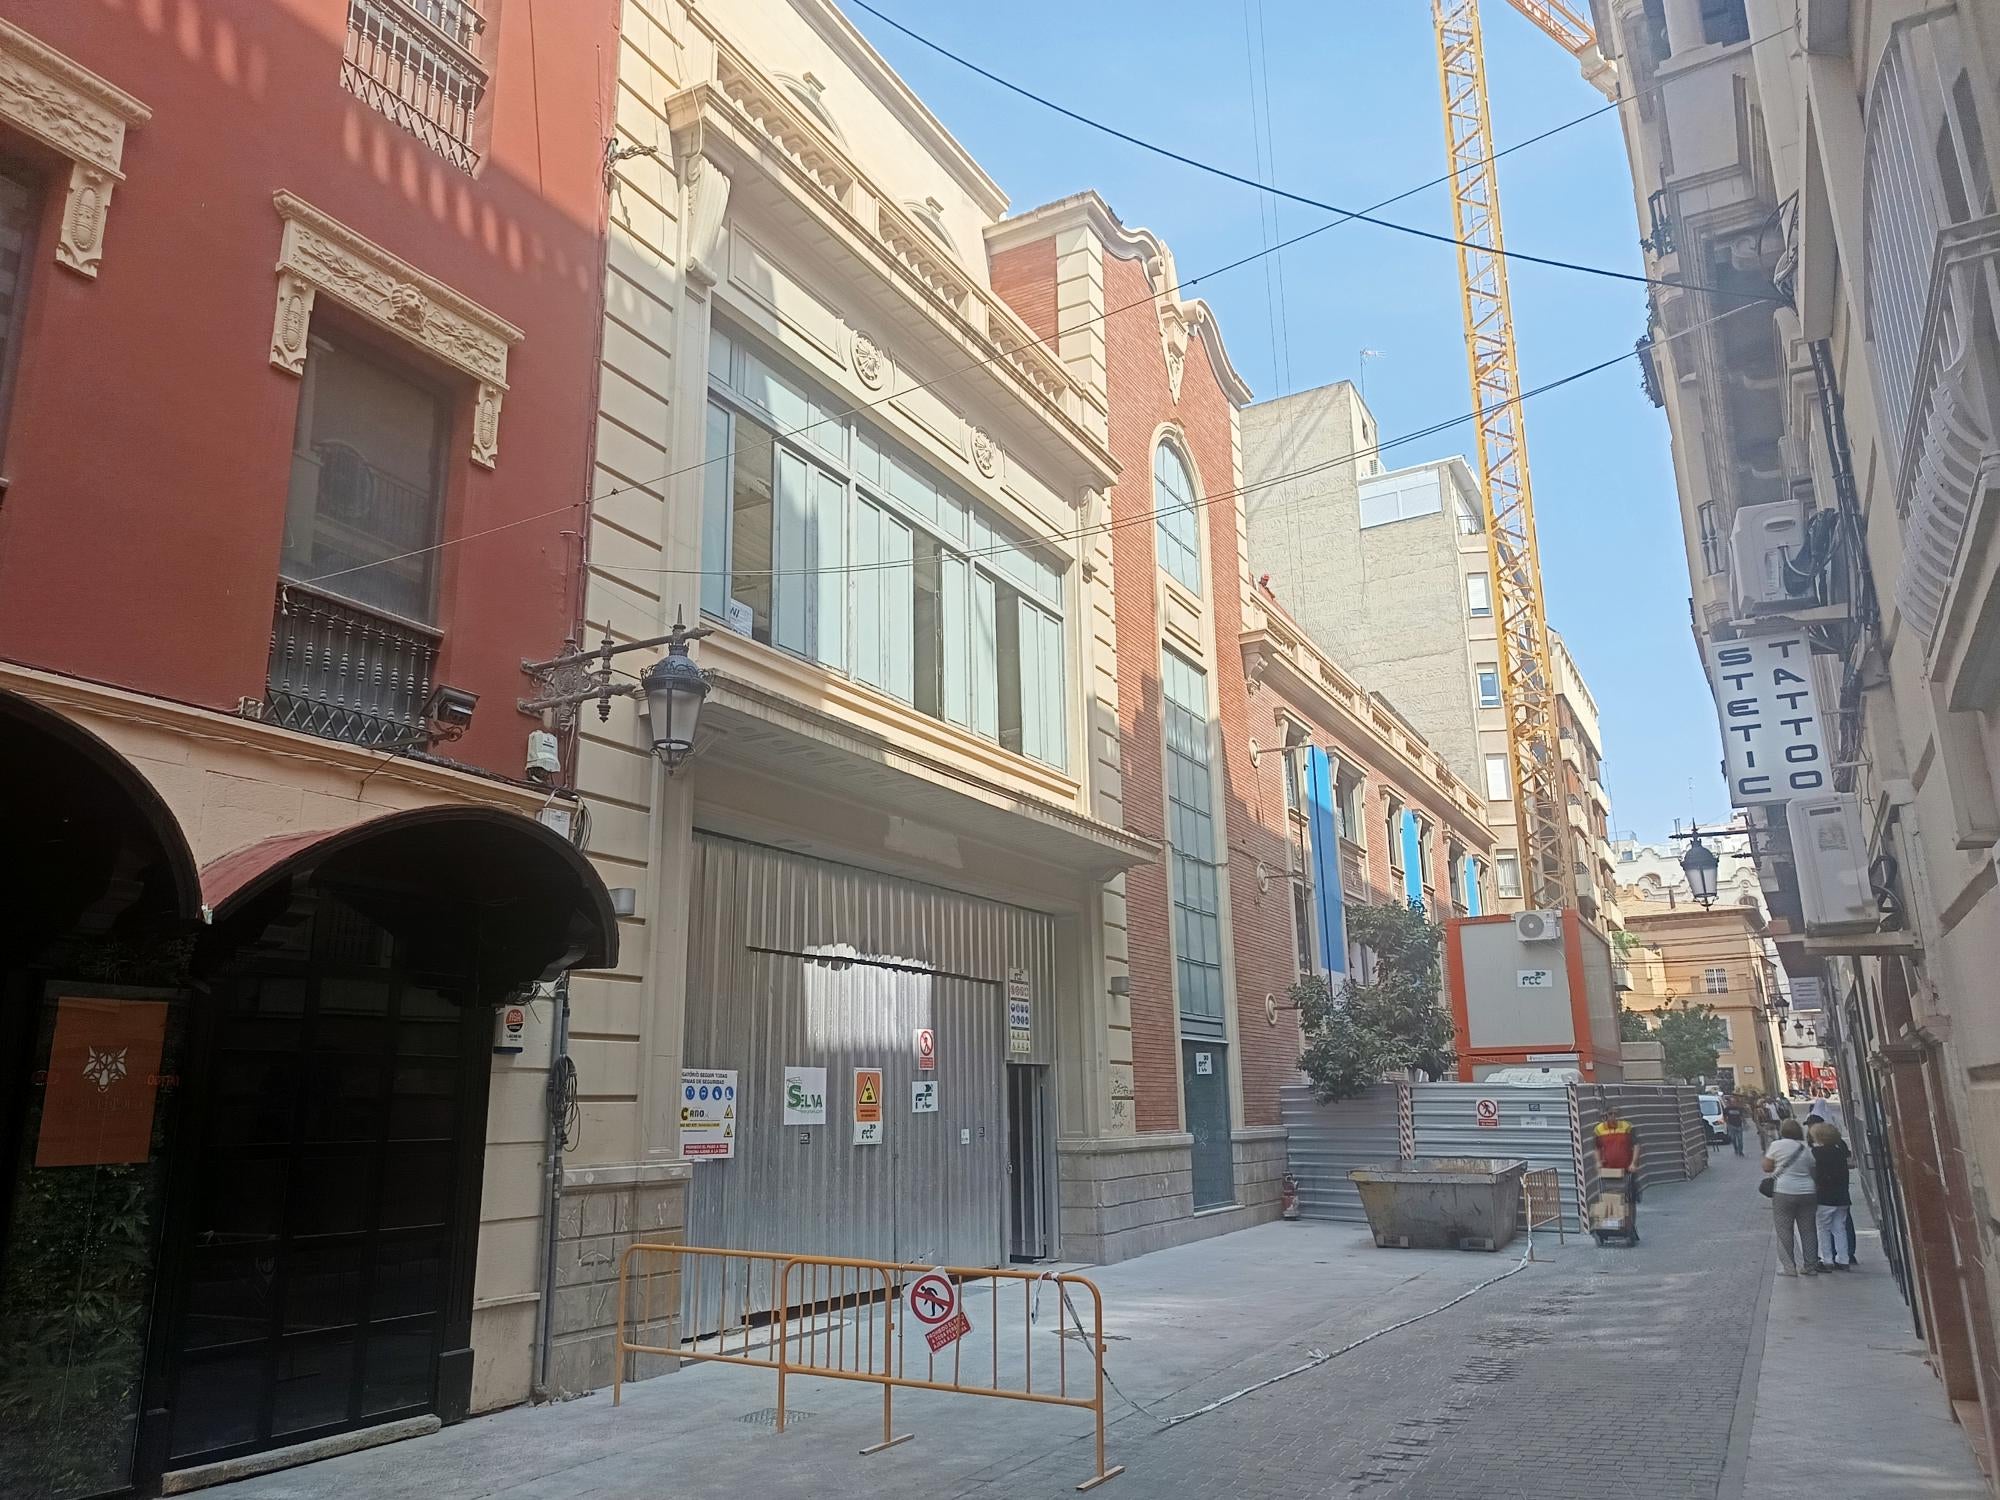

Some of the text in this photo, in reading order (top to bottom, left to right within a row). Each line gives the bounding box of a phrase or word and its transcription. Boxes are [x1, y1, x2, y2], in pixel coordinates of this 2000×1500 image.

[1718, 647, 1772, 795] STETIC
[1768, 640, 1823, 789] TATTOO
[1522, 976, 1542, 985] FCC
